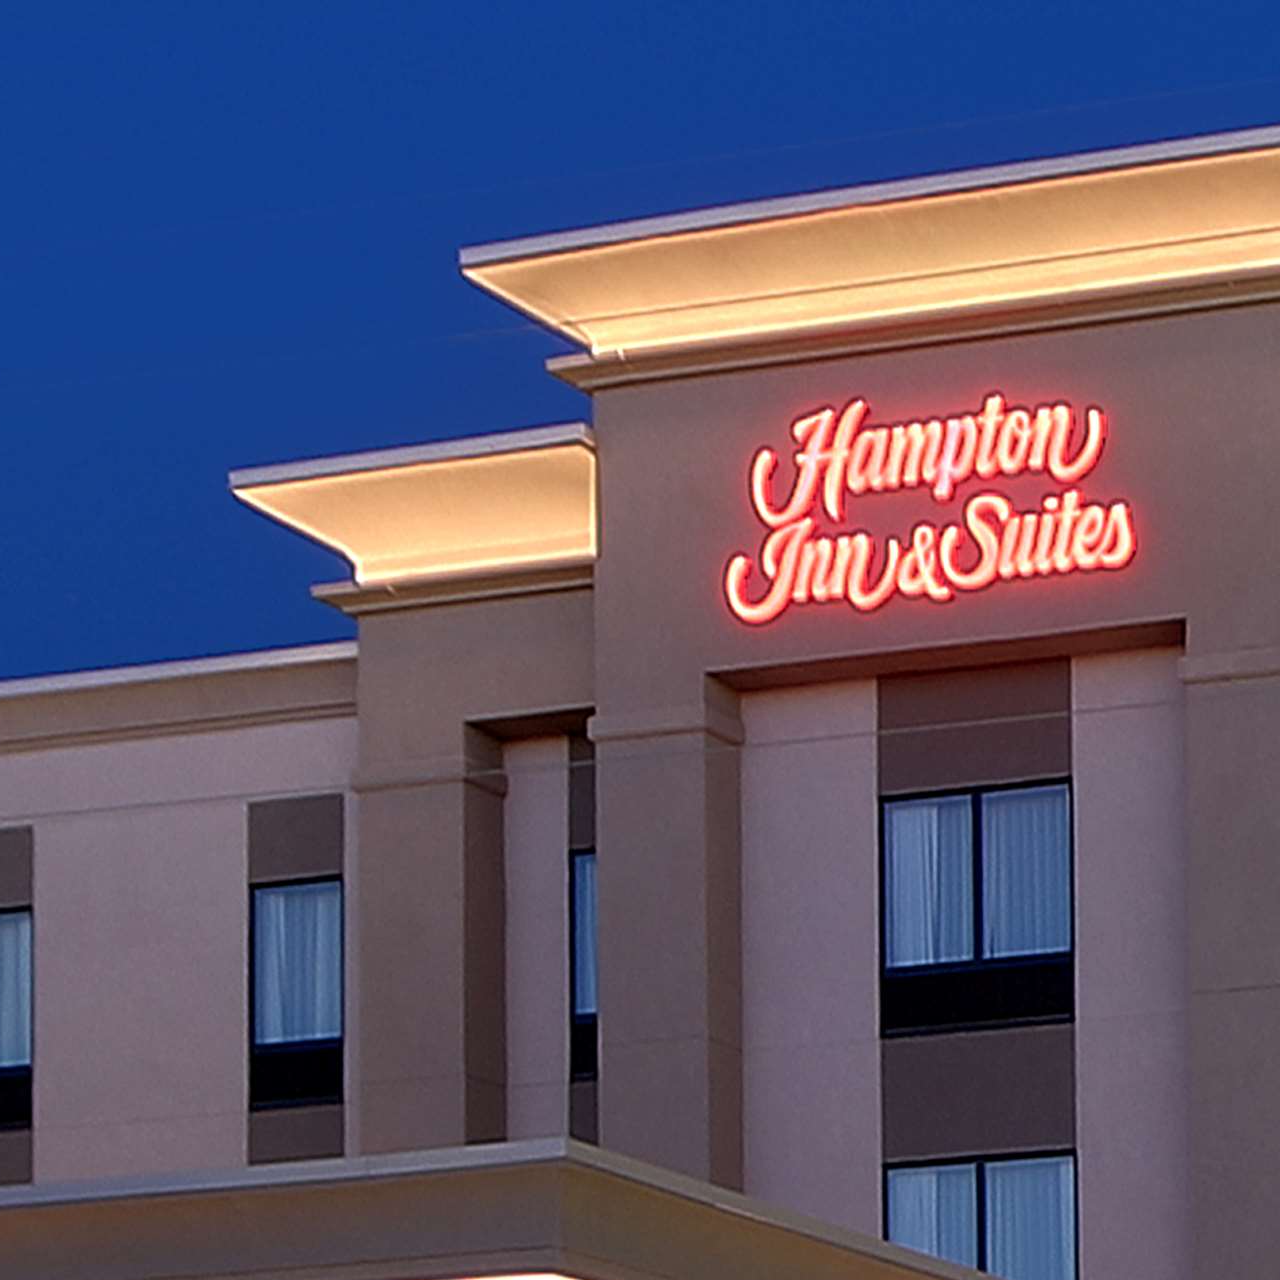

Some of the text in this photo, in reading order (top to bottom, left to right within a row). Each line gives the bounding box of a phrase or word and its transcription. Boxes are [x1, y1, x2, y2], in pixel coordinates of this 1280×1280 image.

[750, 393, 1105, 523] Hampton
[724, 489, 1138, 625] Inn & Suites
